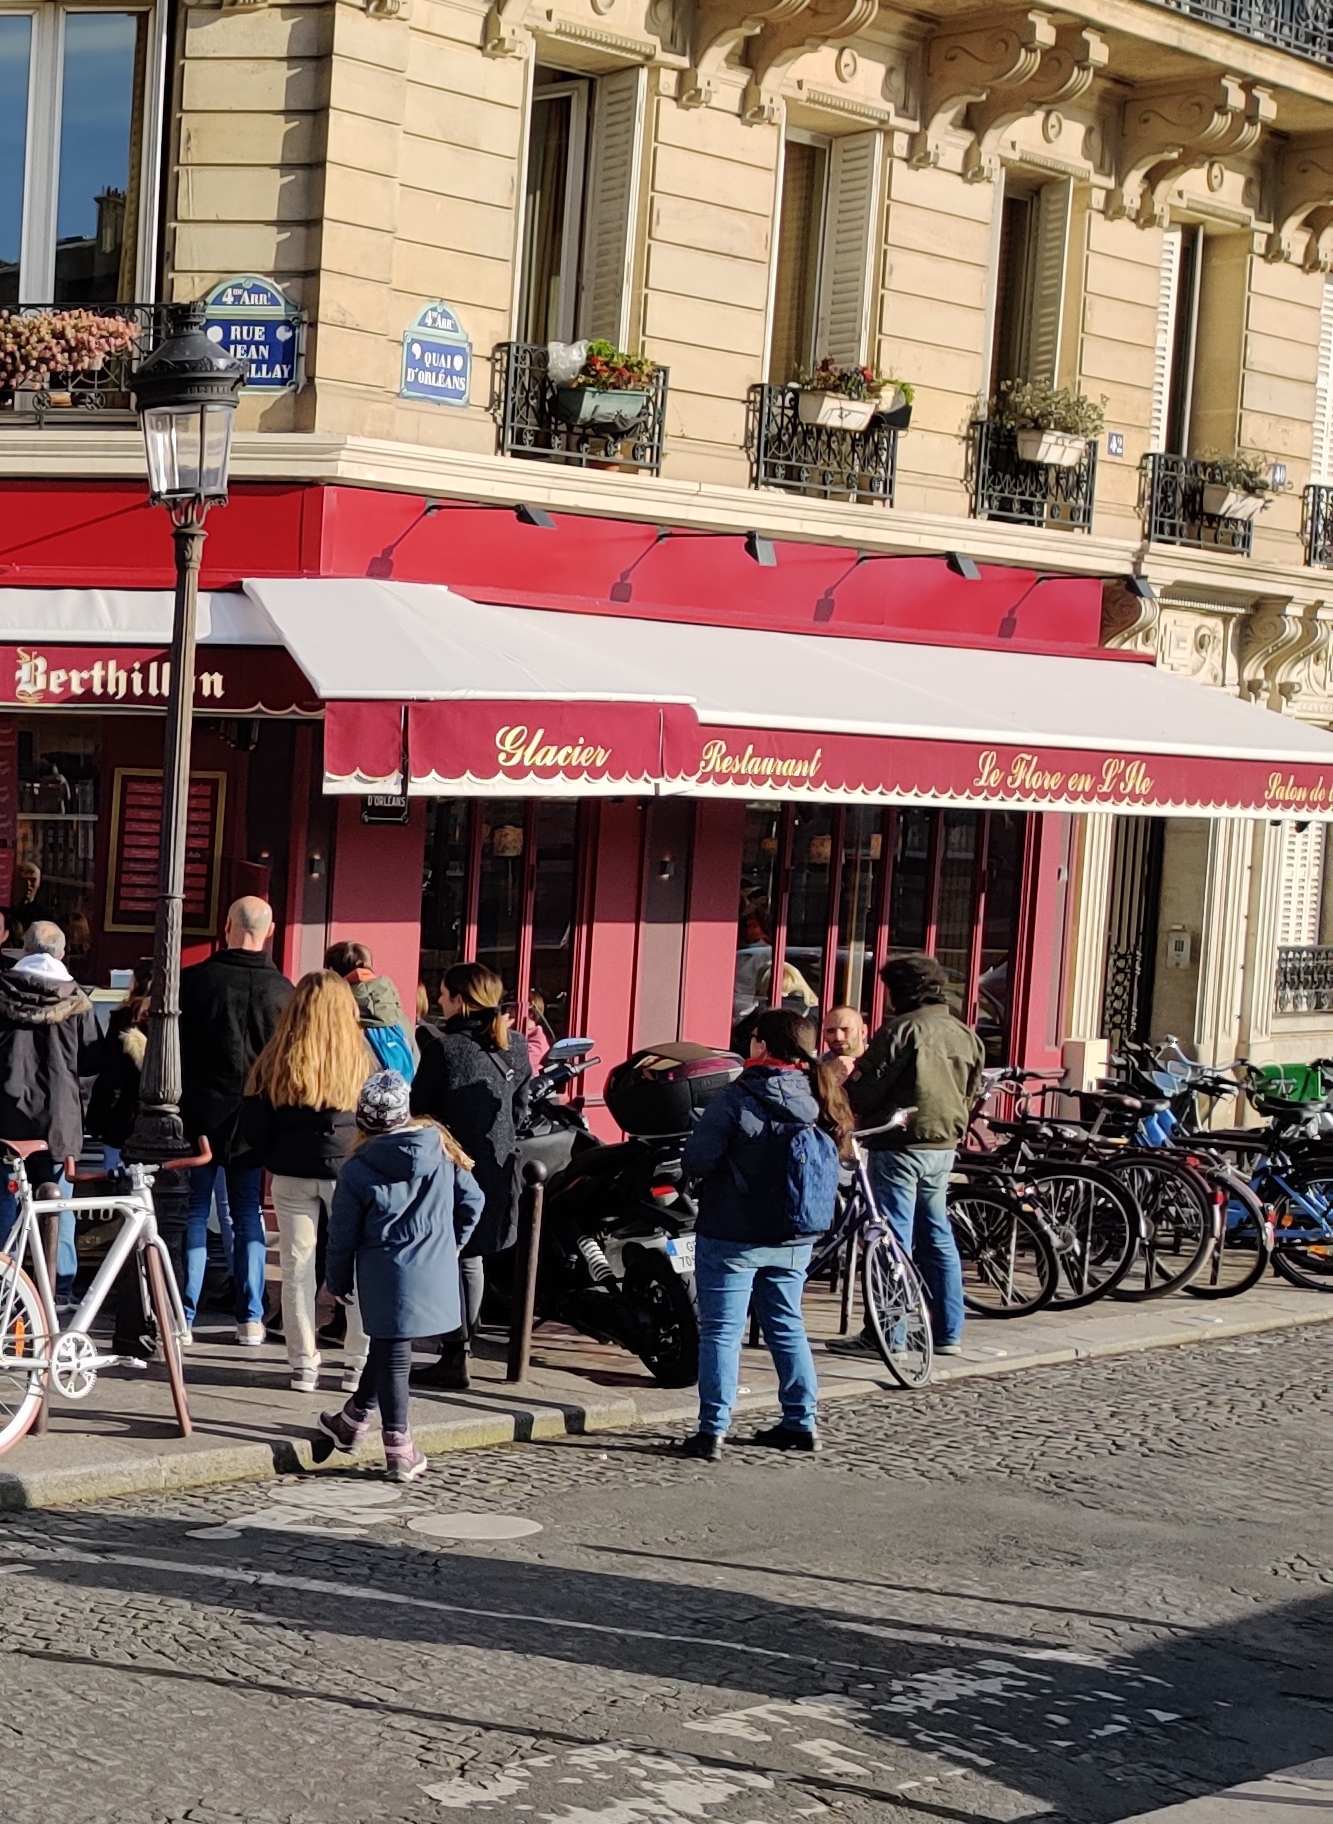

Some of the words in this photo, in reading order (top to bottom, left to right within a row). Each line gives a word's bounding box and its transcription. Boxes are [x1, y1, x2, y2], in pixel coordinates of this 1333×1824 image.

[230, 326, 265, 341] RUE
[246, 364, 291, 379] LLAY
[425, 352, 451, 369] QUAI
[407, 367, 465, 391] D'ORLÉANS
[15, 648, 225, 701] Berthilln
[495, 725, 612, 767] Glacier
[699, 739, 822, 777] Restaurant
[973, 750, 1005, 787] Le
[1007, 753, 1066, 790] Flore
[1067, 772, 1096, 792] en
[1097, 757, 1155, 795] L'Ile
[1264, 772, 1307, 800] Salon
[1309, 776, 1325, 802] de
